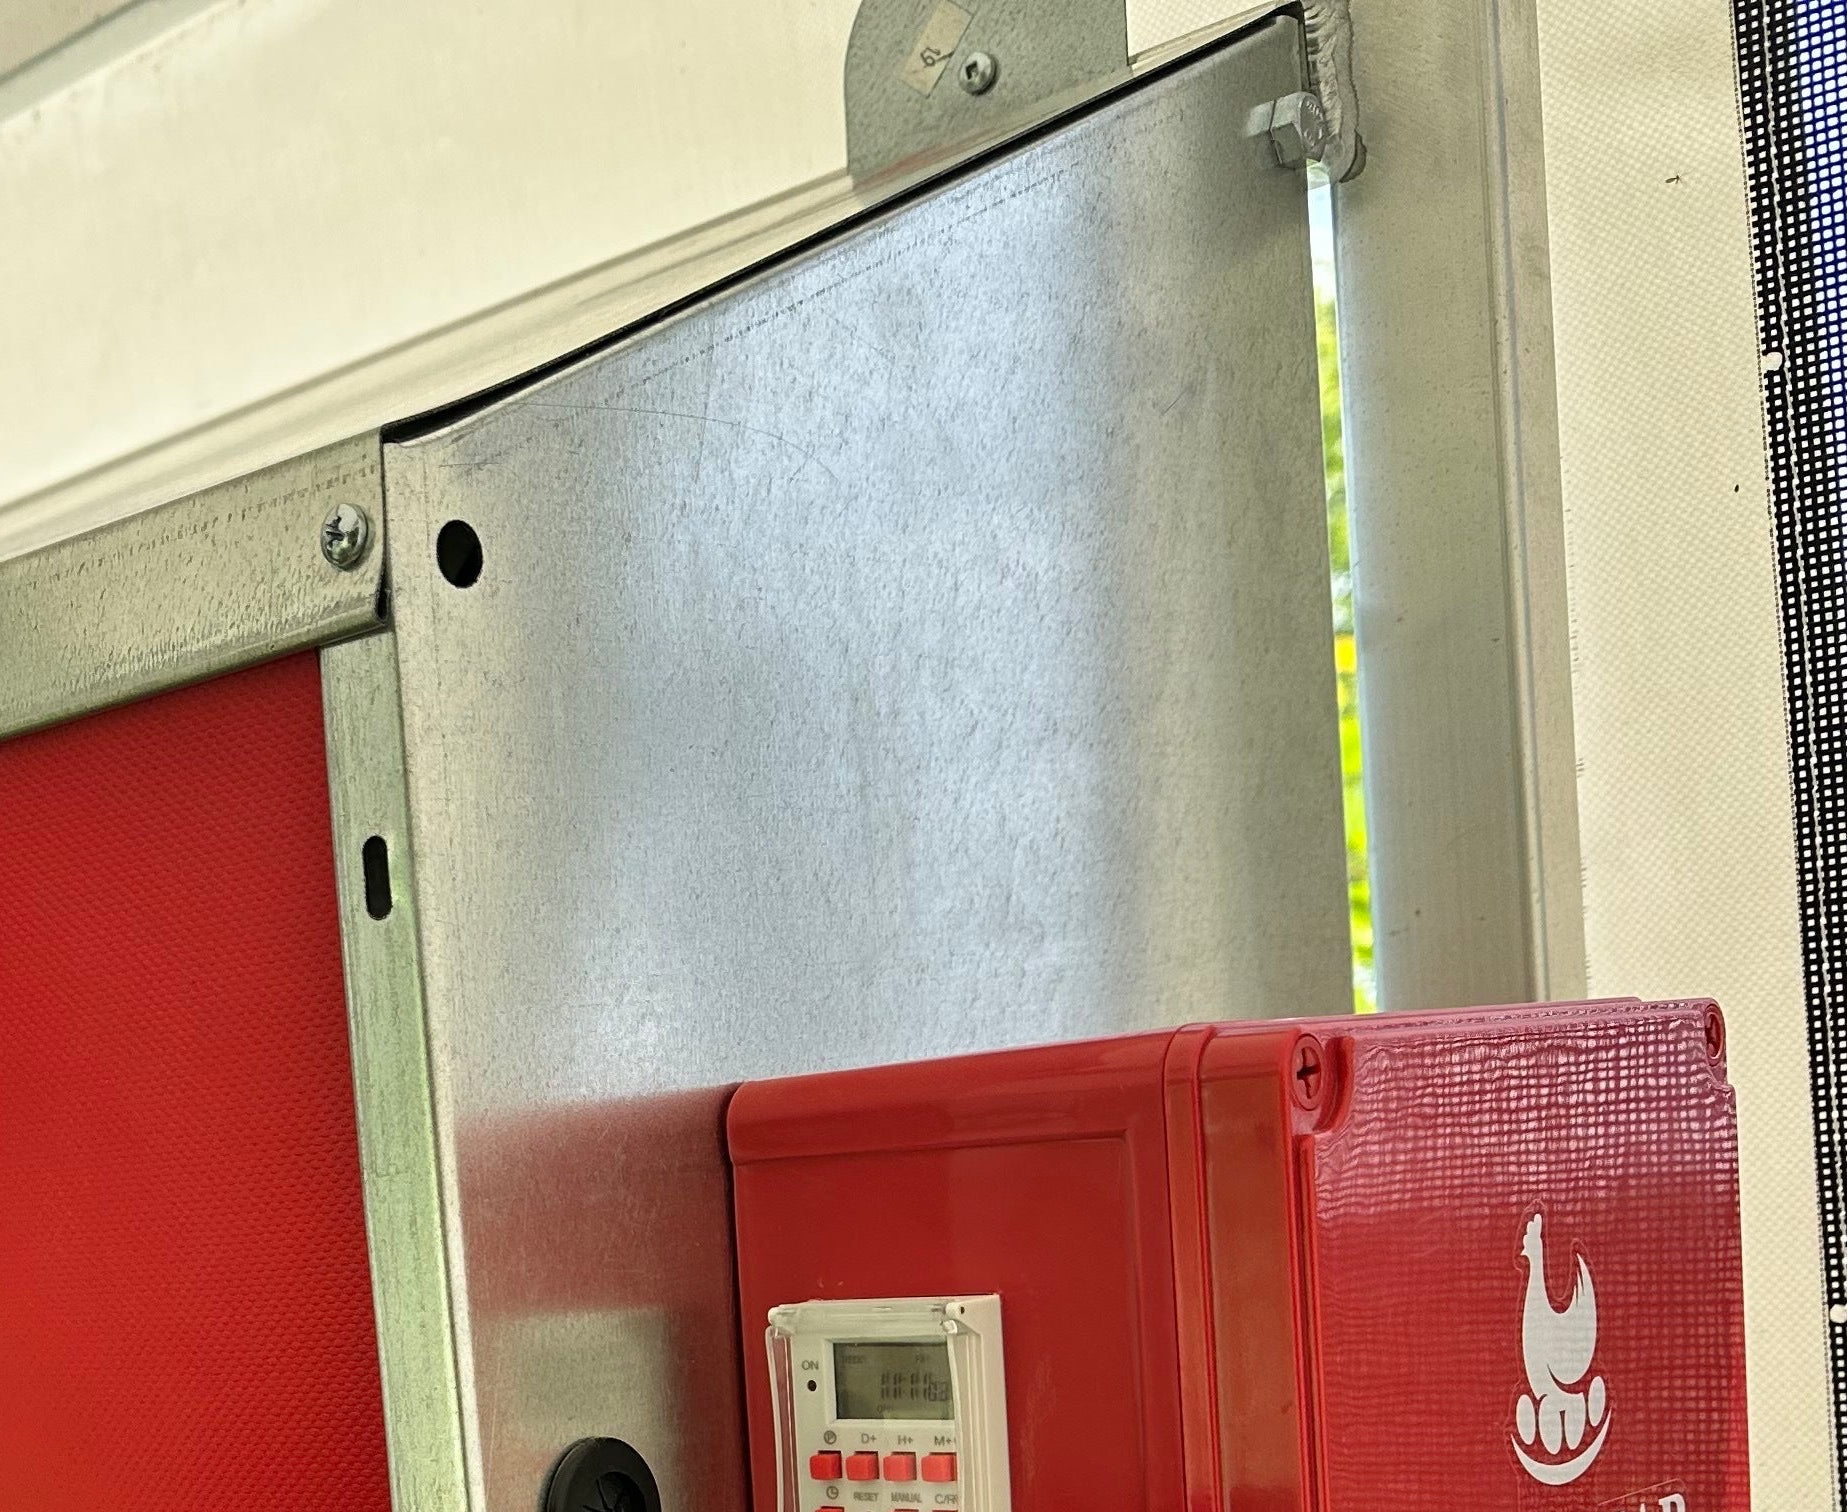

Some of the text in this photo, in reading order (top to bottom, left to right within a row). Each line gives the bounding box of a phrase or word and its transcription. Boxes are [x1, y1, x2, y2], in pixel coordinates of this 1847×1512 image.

[801, 1359, 819, 1371] ON
[861, 1432, 877, 1444] D+
[897, 1434, 914, 1445] H+
[853, 1491, 880, 1503] RESET
[890, 1491, 923, 1504] MANUAL
